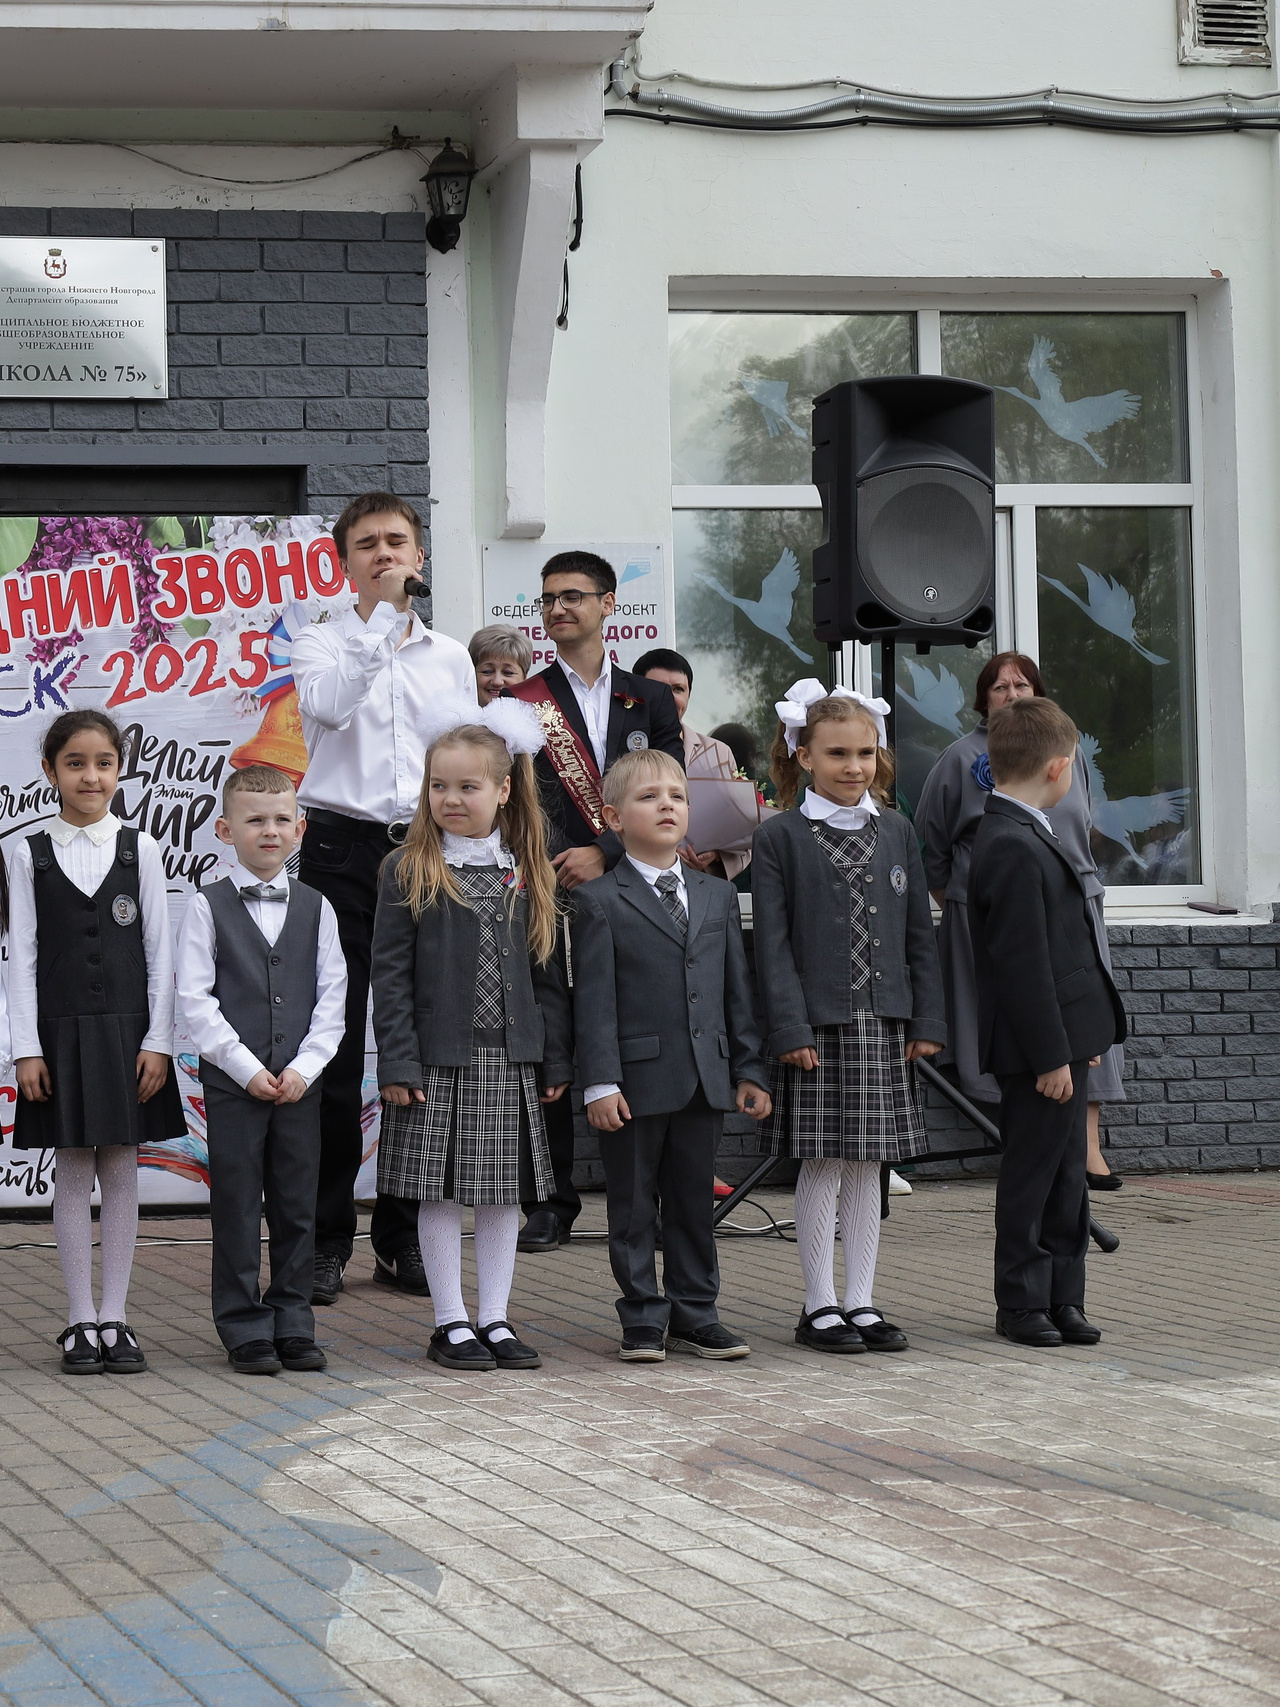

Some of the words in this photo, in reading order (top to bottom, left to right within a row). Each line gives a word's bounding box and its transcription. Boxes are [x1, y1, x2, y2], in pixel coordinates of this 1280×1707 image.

[37, 287, 66, 295] города
[68, 286, 108, 294] Нижнего
[110, 287, 156, 296] Новгорода
[6, 296, 63, 305] Департамент
[64, 297, 119, 306] образования
[72, 319, 145, 328] БЮДЖЕТНОЕ
[18, 342, 95, 350] УЧРЕЖДЕНИЕ
[80, 365, 108, 382] №
[114, 364, 147, 383] 75»
[155, 536, 358, 620] ЗВОНО
[612, 604, 657, 616] РОЕКТ
[600, 625, 658, 643] ДОГО
[102, 630, 274, 709] 2025
